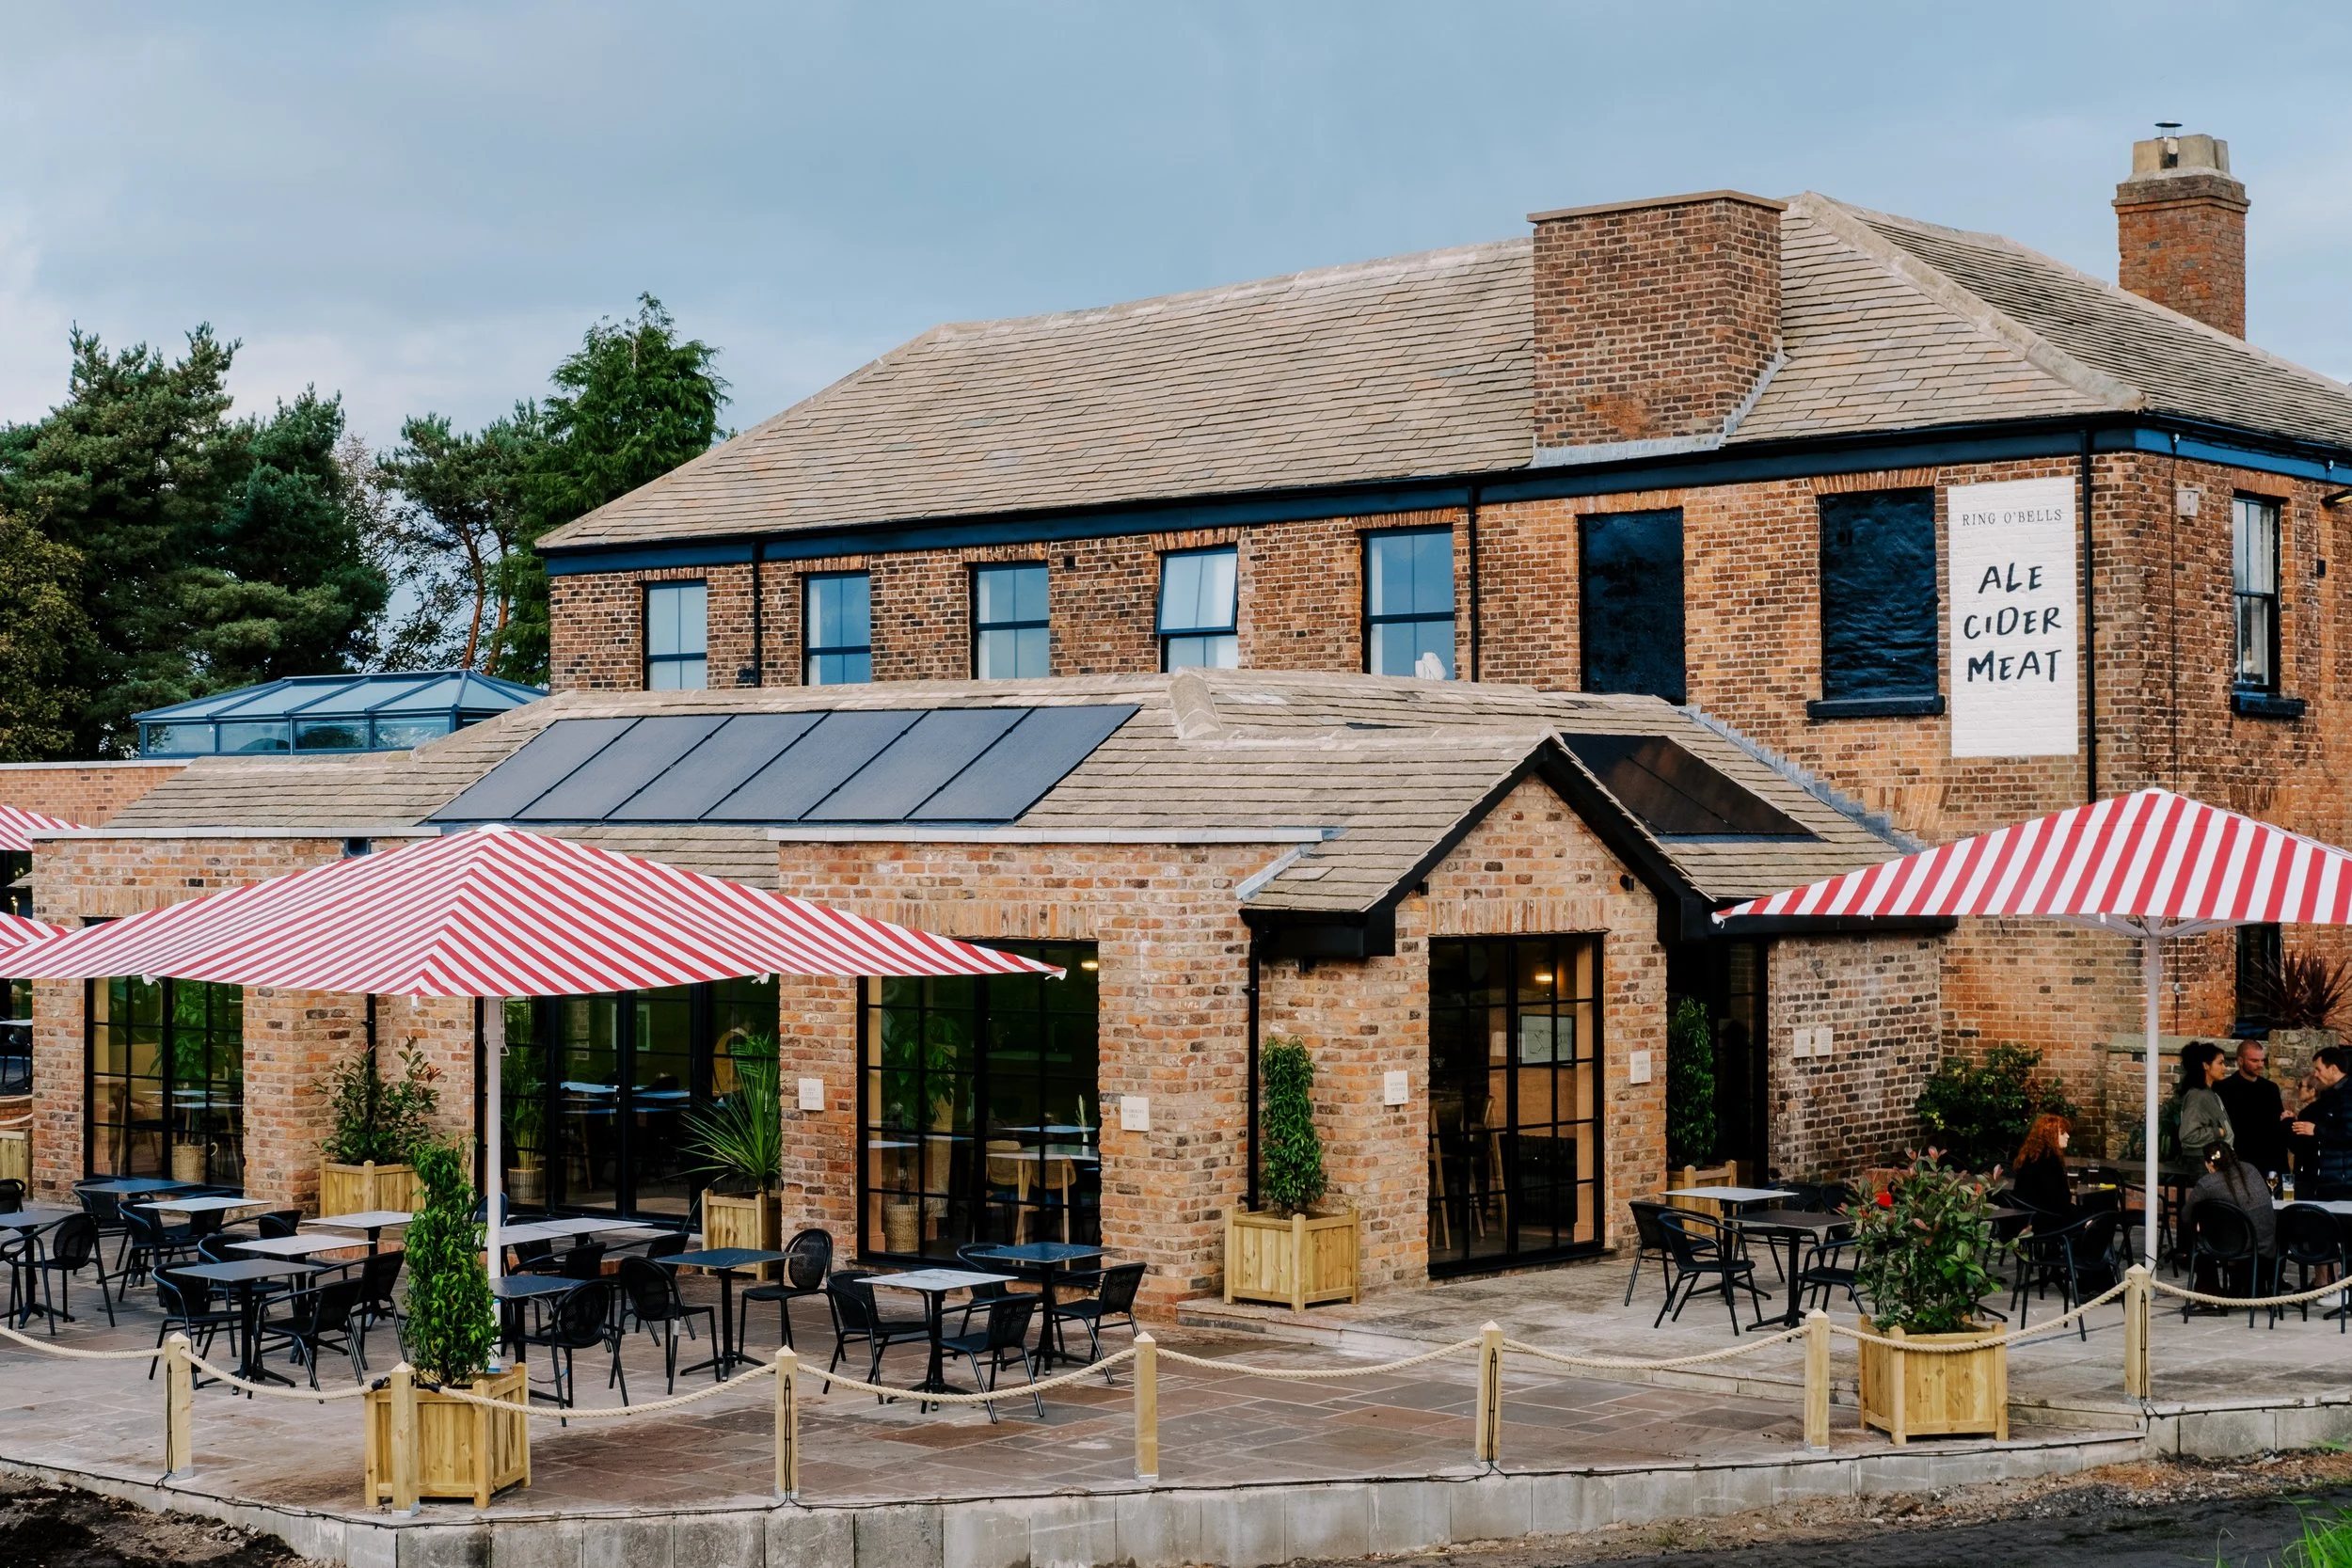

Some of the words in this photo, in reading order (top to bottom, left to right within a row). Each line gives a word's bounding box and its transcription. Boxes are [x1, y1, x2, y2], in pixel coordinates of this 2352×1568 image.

[1963, 513, 1995, 526] RING
[2004, 509, 2062, 524] O'BELLS
[1978, 562, 2042, 594] ALE
[1963, 607, 2062, 640] CIDER
[1967, 649, 2062, 682] MEAT
